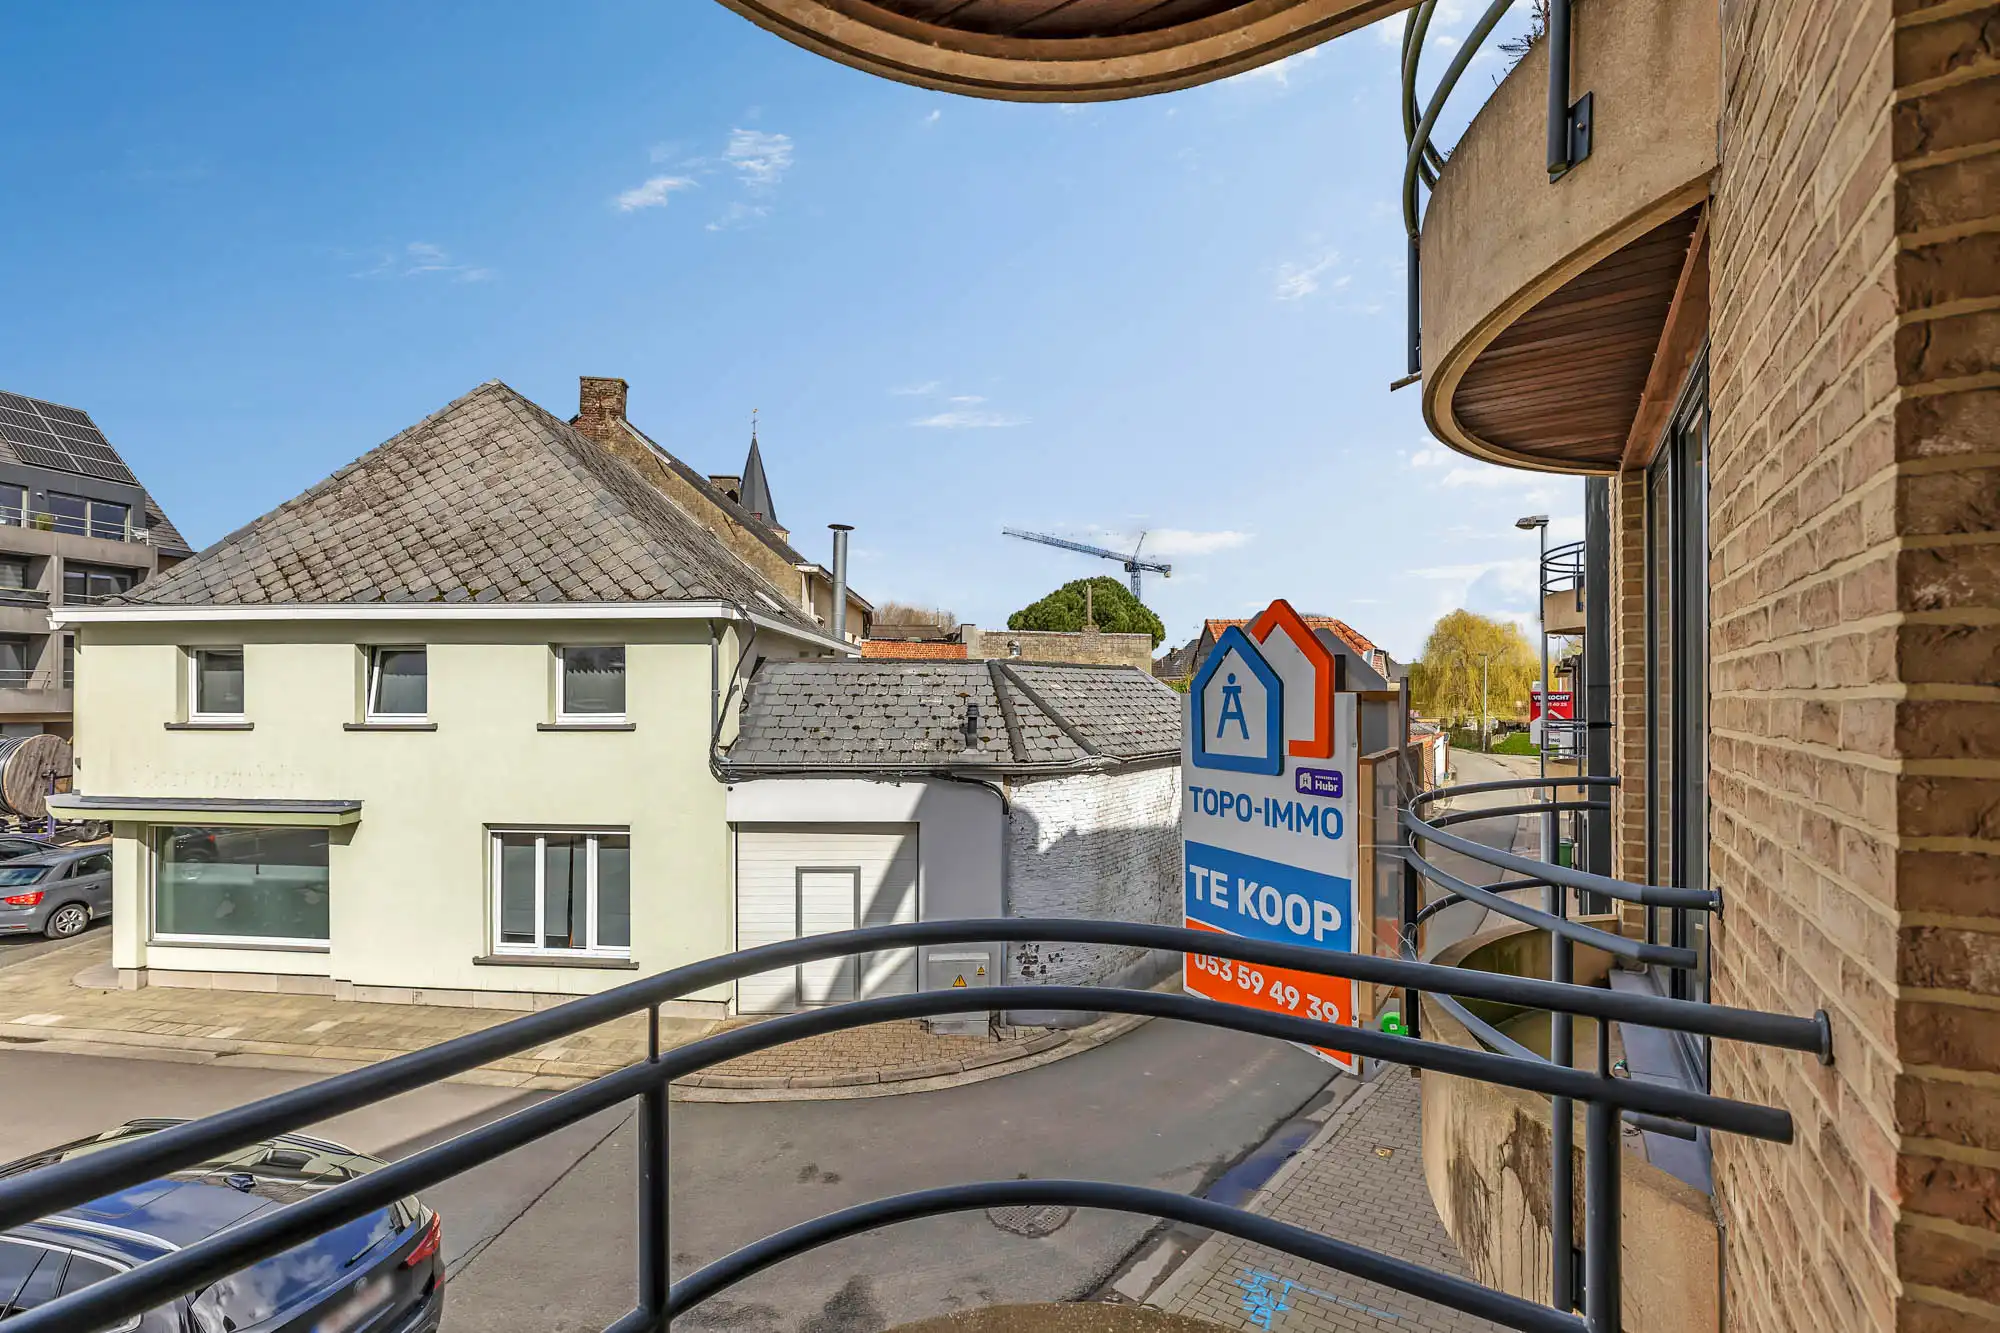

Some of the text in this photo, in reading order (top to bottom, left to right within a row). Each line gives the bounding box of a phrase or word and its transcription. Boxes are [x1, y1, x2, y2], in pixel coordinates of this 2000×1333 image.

[1188, 785, 1344, 840] TOPO-IMMO
[1314, 779, 1339, 792] Hubr
[1189, 864, 1342, 943] TE KOOP
[1194, 951, 1340, 1025] 053 59 49 39
